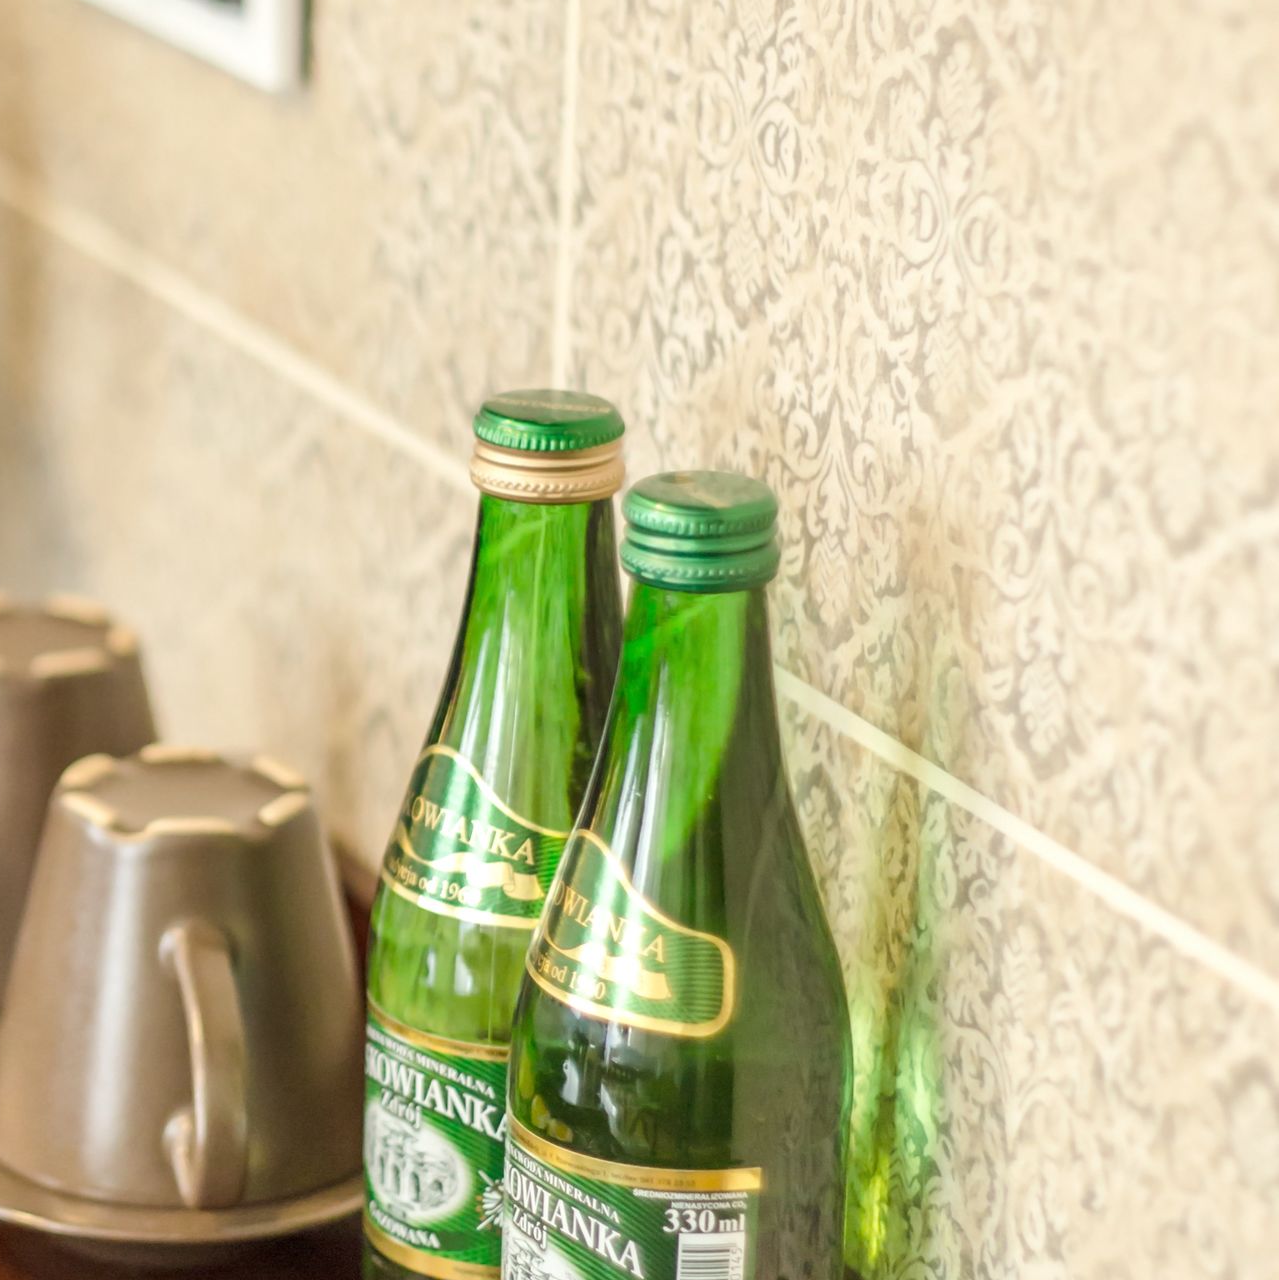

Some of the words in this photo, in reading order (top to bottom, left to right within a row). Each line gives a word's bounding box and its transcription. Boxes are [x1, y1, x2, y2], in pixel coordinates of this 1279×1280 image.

[551, 965, 568, 984] od
[415, 1051, 496, 1099] MINERALNA
[543, 1170, 620, 1224] MINERALNA
[512, 1203, 548, 1250] Zdrój
[662, 1208, 716, 1234] 330
[718, 1213, 746, 1233] ml
